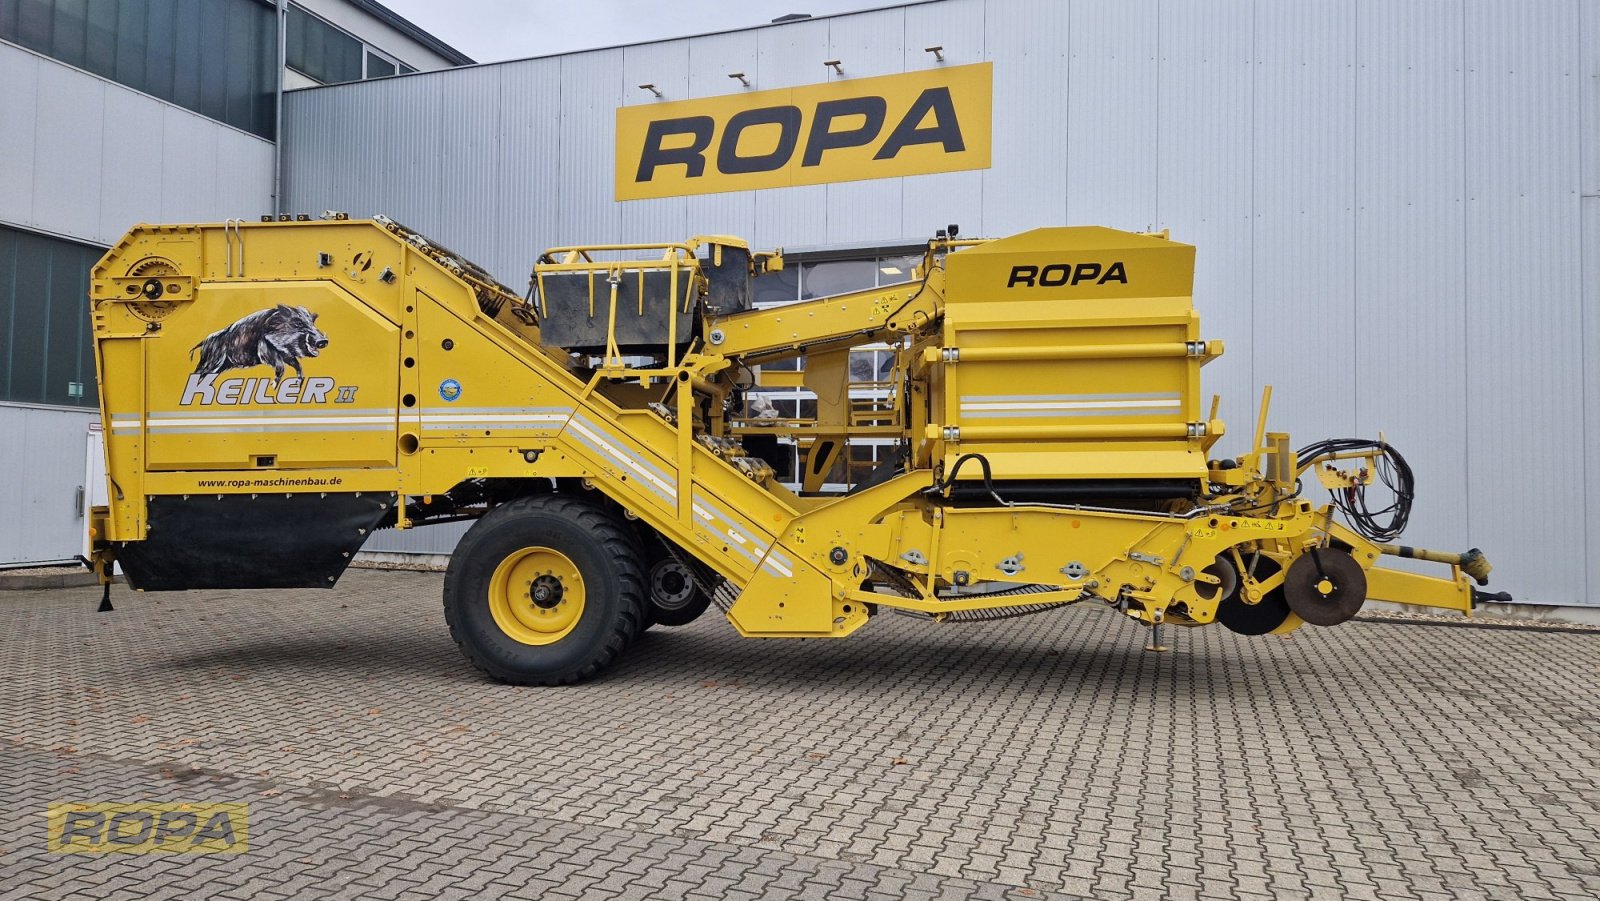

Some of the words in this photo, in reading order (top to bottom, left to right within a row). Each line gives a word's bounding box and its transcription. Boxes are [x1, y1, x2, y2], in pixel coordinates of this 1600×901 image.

[635, 86, 966, 183] ROPA
[1007, 262, 1128, 288] ROPA
[179, 373, 335, 405] KEILER
[334, 386, 359, 404] II
[198, 477, 343, 489] www.ropa-maschinenbau.de
